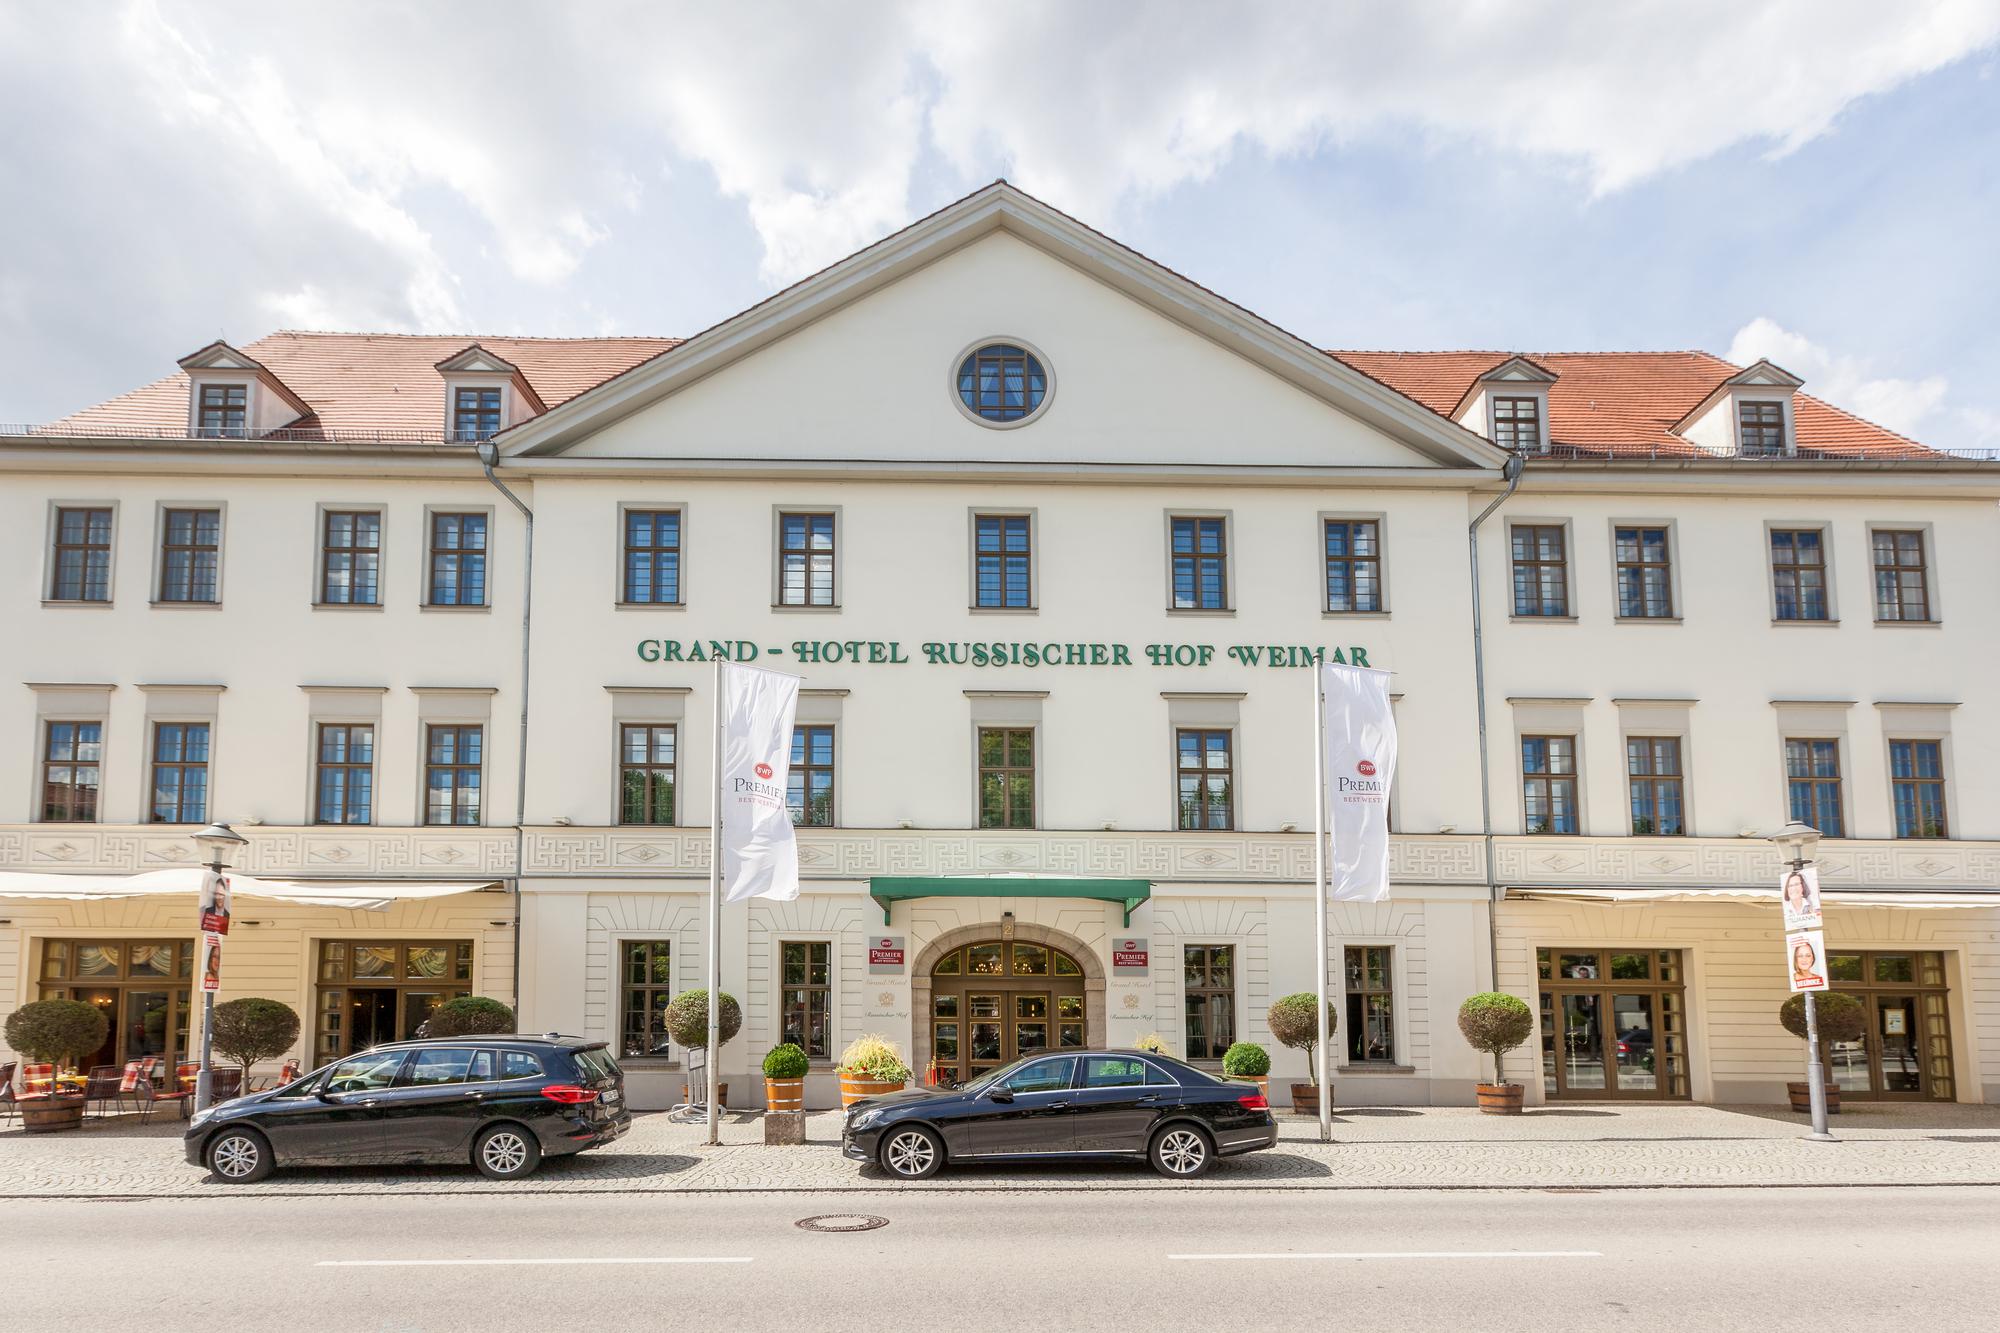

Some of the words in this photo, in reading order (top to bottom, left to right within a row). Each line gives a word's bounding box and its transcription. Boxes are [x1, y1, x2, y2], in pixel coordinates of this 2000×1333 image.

[637, 639, 759, 663] GRAND
[791, 640, 909, 664] HOTEL
[921, 642, 1133, 668] RUSSISCHER
[1145, 643, 1216, 667] HOF
[1003, 924, 1013, 935] 2
[872, 950, 902, 958] PREMIER
[1116, 952, 1146, 960] PREMIER
